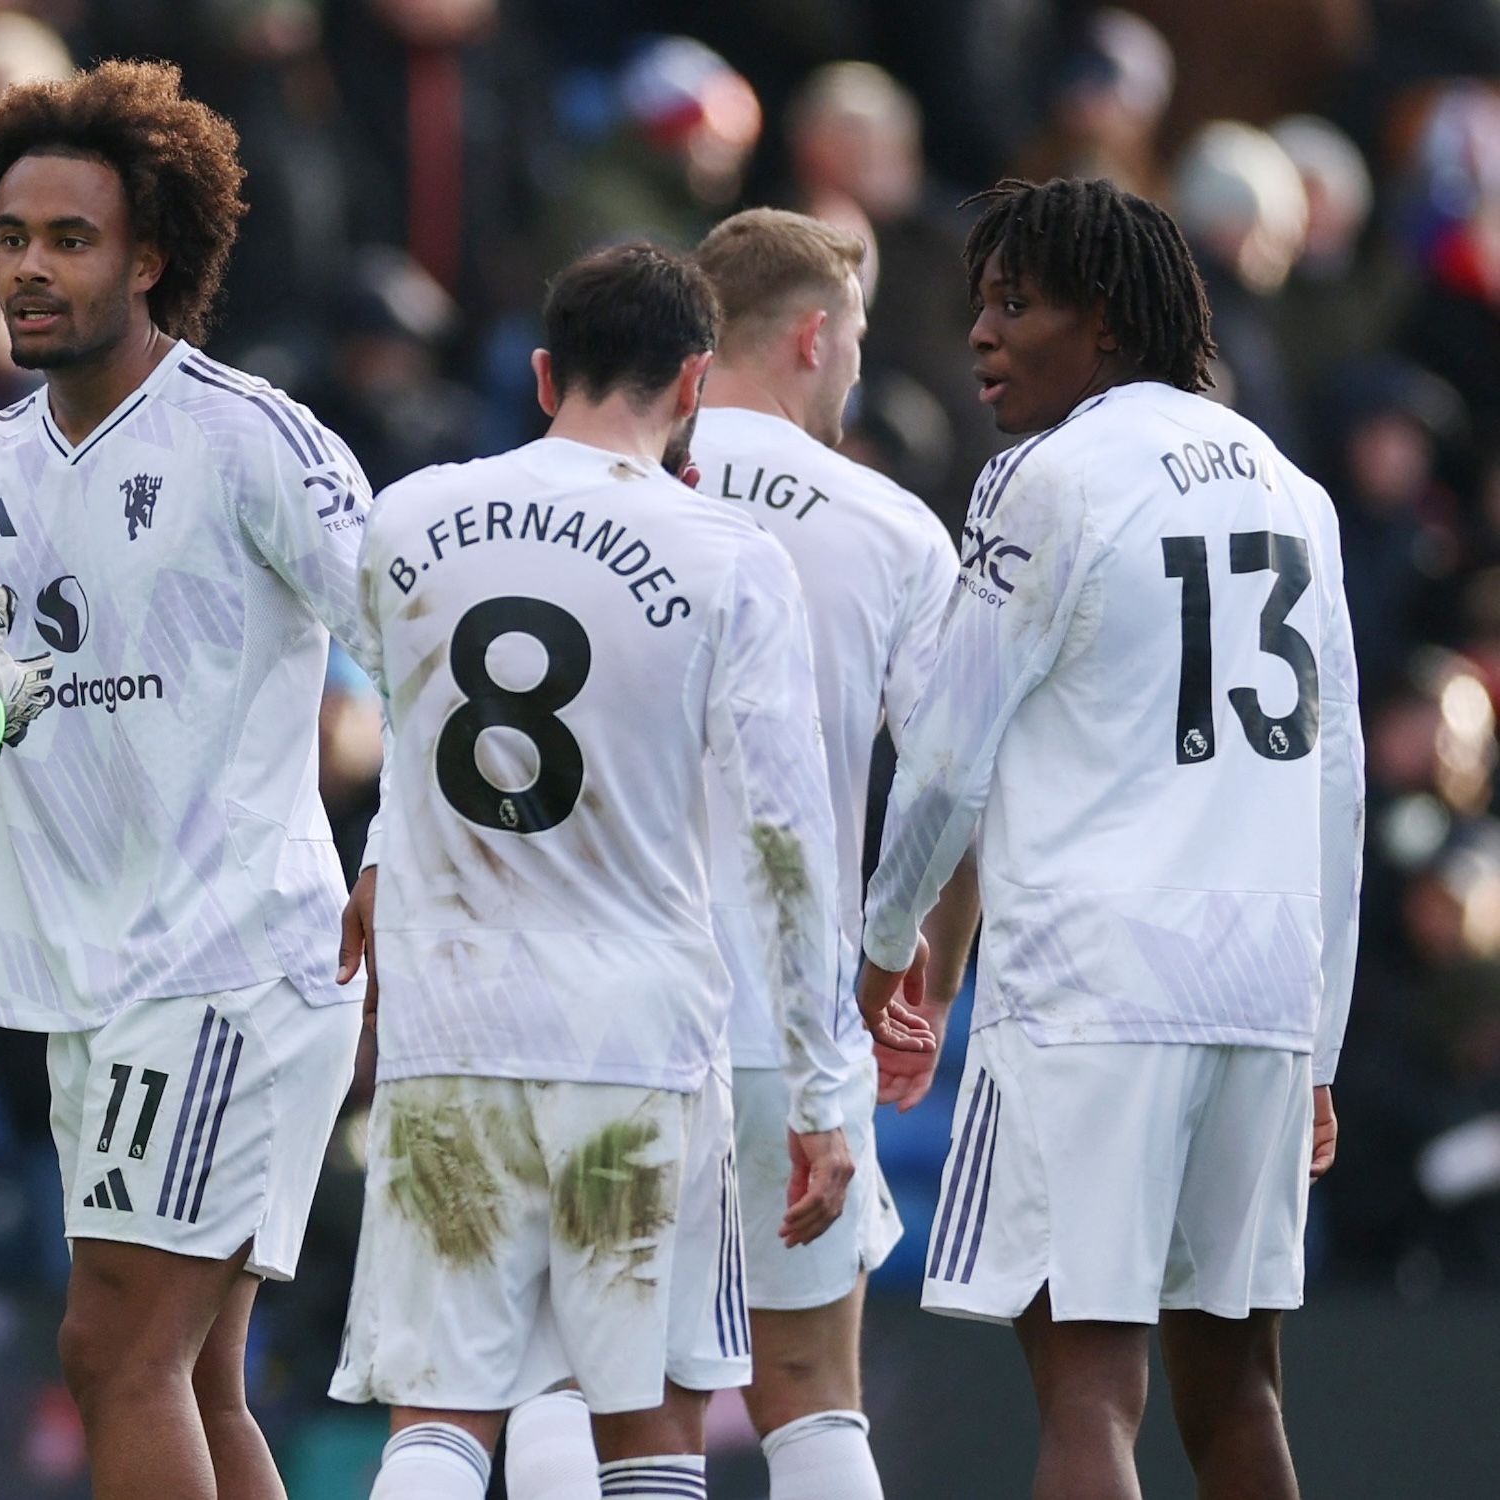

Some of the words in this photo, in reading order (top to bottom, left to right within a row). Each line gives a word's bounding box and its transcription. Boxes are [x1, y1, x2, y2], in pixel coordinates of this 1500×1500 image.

[721, 463, 831, 521] LIGT
[389, 501, 691, 628] B.FERNANDES
[1160, 530, 1320, 765] 13
[435, 595, 592, 834] 8
[97, 1063, 169, 1160] 11
